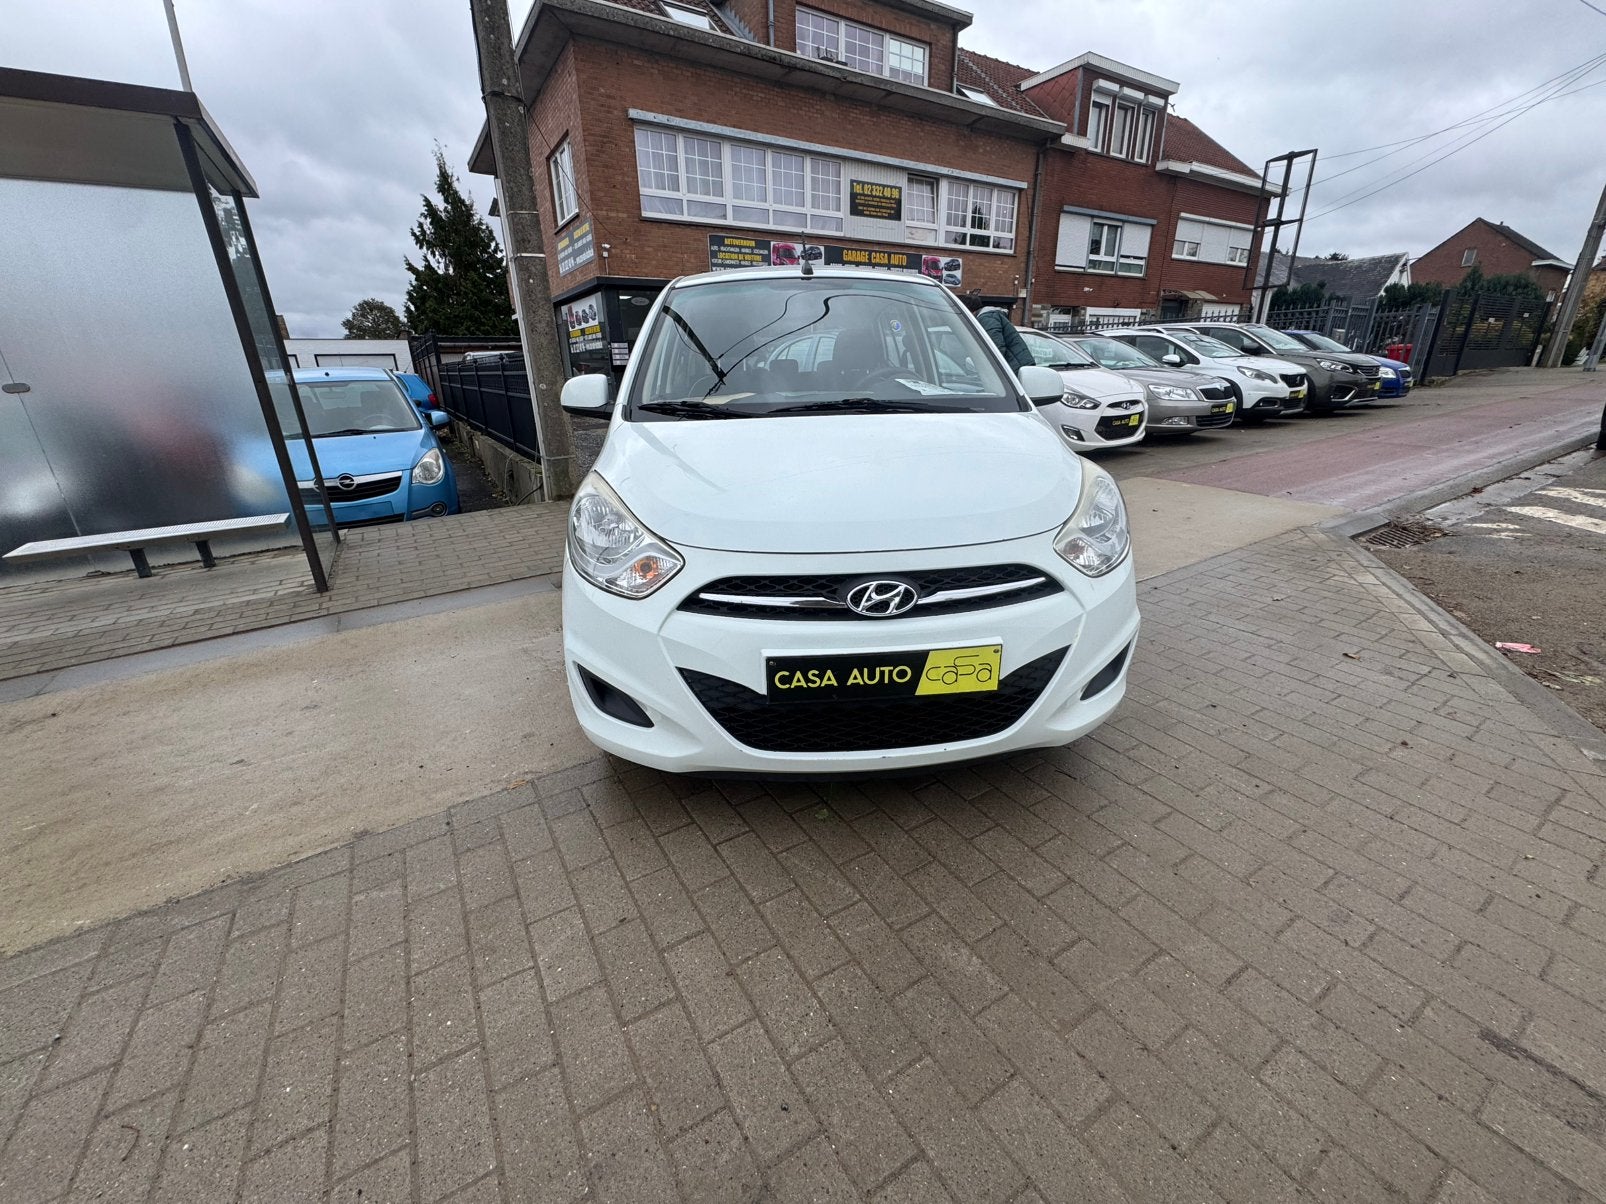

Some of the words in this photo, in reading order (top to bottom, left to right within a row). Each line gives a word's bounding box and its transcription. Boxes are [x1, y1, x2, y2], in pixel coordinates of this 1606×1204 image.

[842, 249, 869, 263] GARAGE
[871, 252, 889, 265] CASA
[890, 254, 907, 266] AUTO
[774, 669, 838, 690] CASA
[846, 665, 913, 687] AUTO
